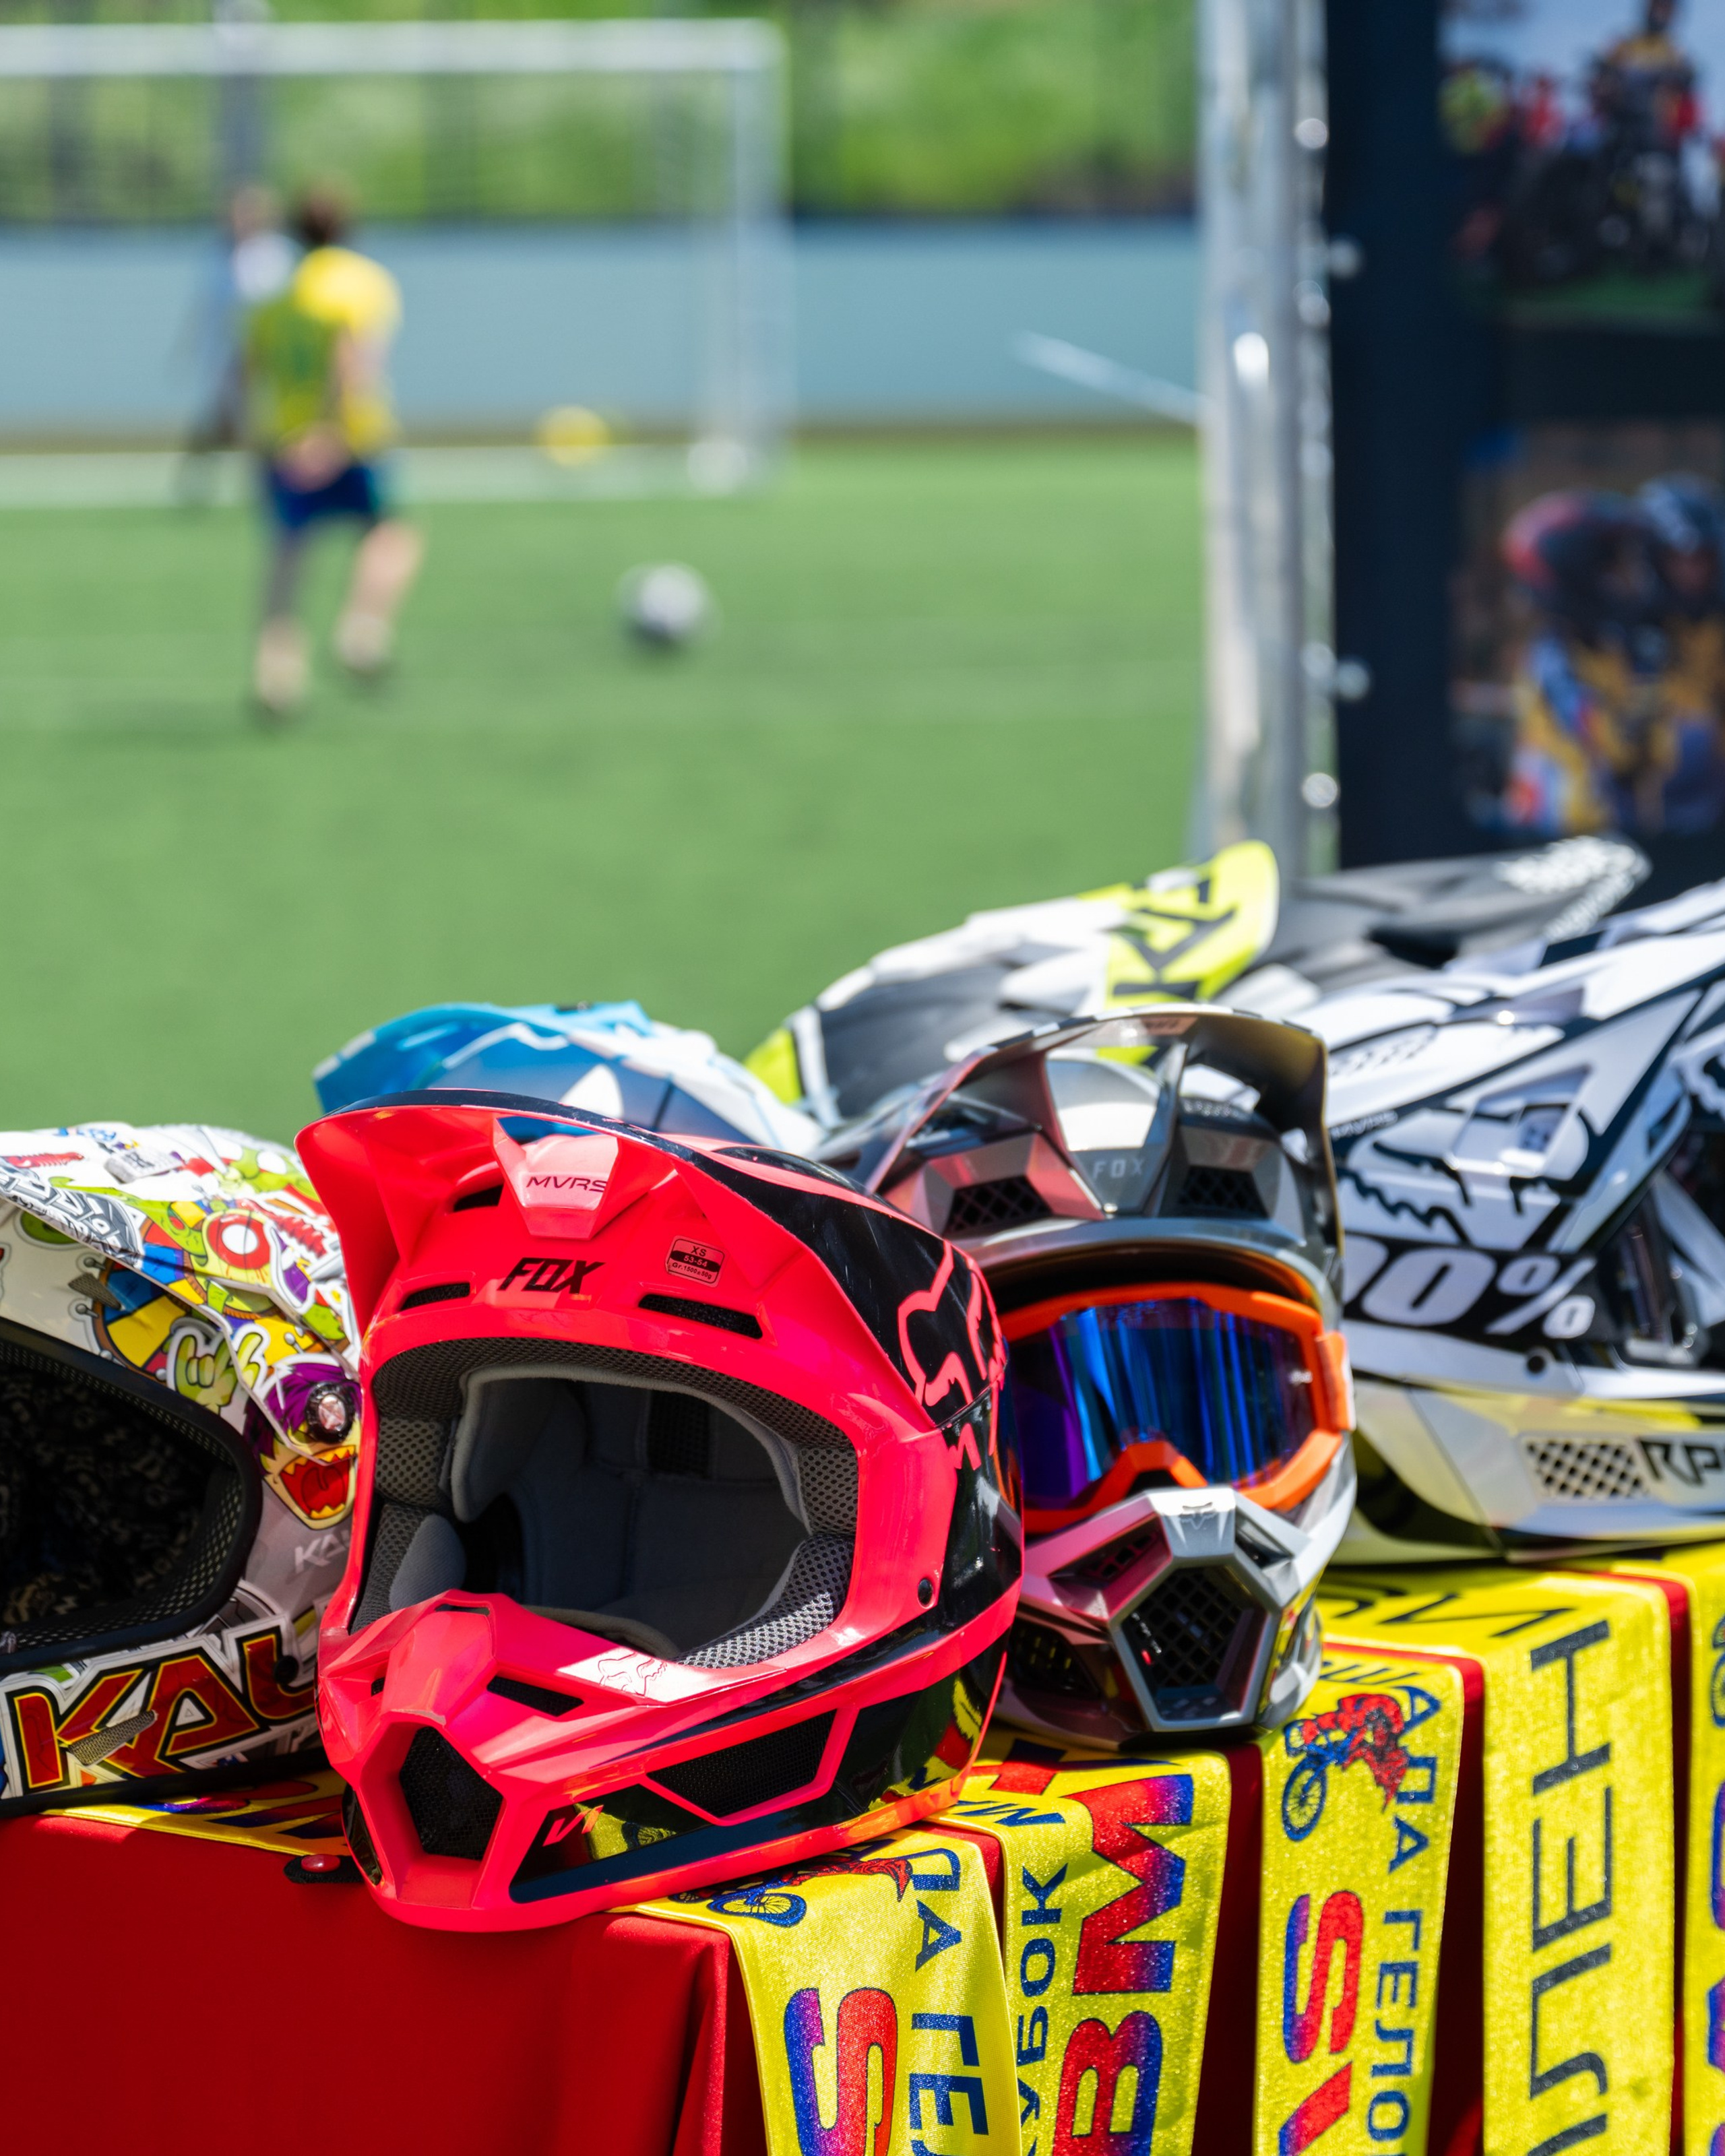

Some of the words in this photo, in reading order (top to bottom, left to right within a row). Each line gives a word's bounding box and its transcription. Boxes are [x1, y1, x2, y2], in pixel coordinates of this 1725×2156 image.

[1092, 1157, 1144, 1180] FOX
[526, 1176, 608, 1193] MVRS
[683, 1255, 708, 1267] 53-54
[691, 1245, 707, 1257] XS
[497, 1257, 606, 1295] FOX
[1016, 1863, 1069, 2156] УБОК
[1366, 1909, 1422, 2156] ГЕЛО
